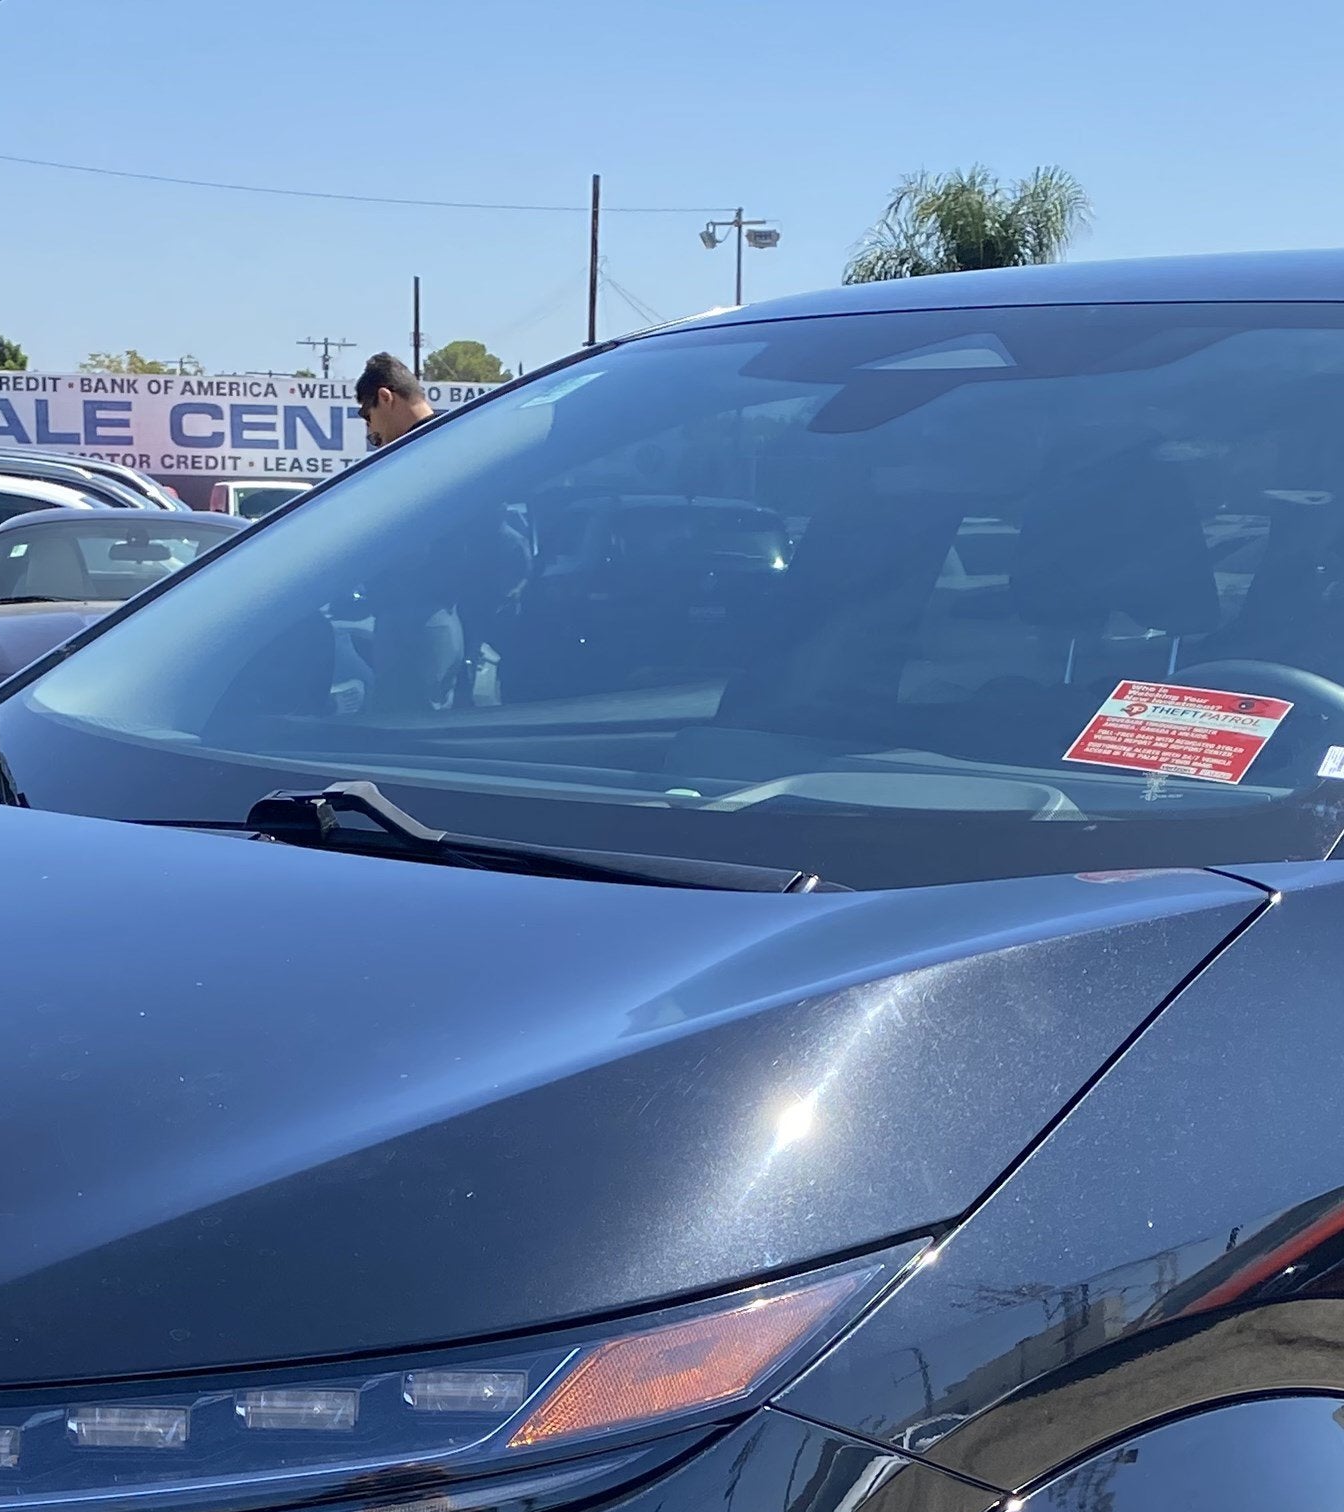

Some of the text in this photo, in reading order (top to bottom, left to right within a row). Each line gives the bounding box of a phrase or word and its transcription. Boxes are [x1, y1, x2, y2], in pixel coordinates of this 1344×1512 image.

[80, 377, 139, 394] BANK
[147, 379, 174, 395] OF
[180, 380, 278, 398] AMERICA
[298, 383, 357, 400] WELL
[450, 387, 492, 402] BA
[161, 454, 242, 471] CREDIT
[263, 456, 334, 473] LEASE
